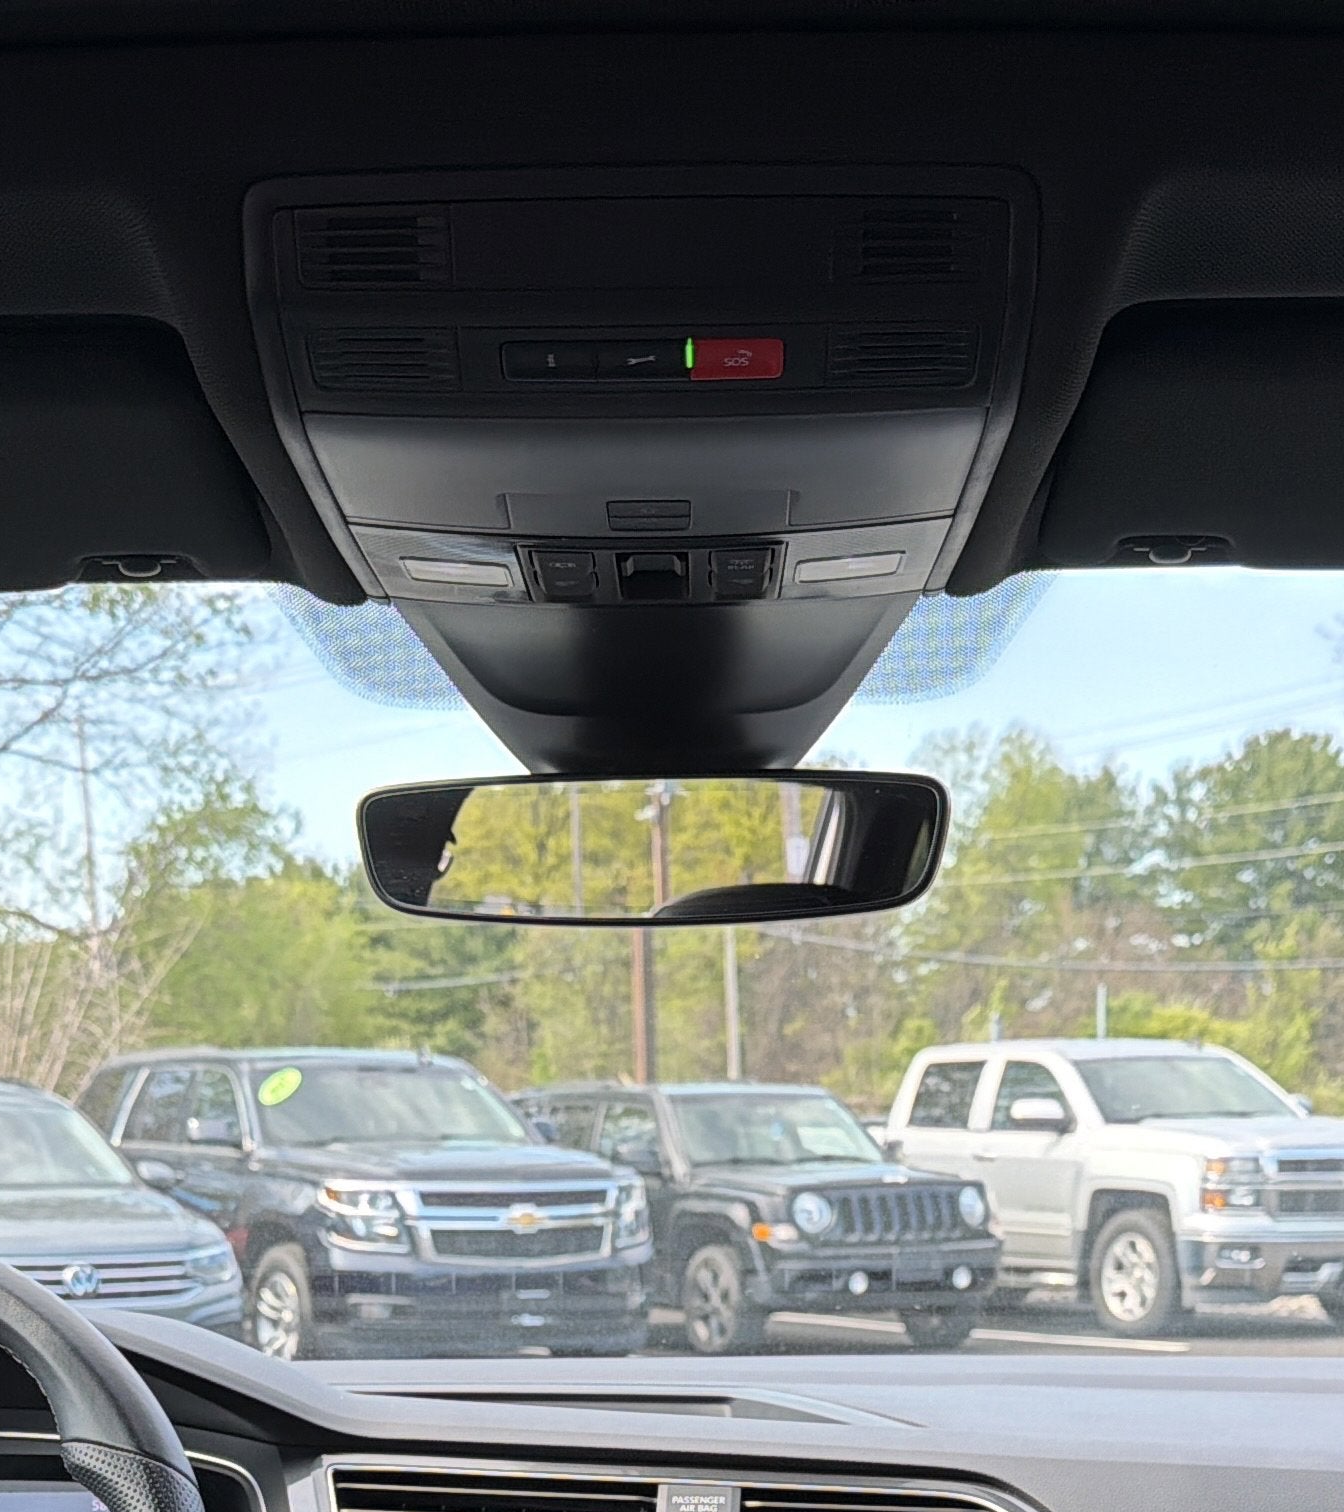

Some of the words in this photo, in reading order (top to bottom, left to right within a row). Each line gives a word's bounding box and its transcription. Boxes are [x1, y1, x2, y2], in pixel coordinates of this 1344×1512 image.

[723, 357, 750, 367] SOS
[671, 1495, 726, 1504] PASSENGER
[679, 1504, 696, 1512] AIR
[697, 1504, 718, 1512] BAG
